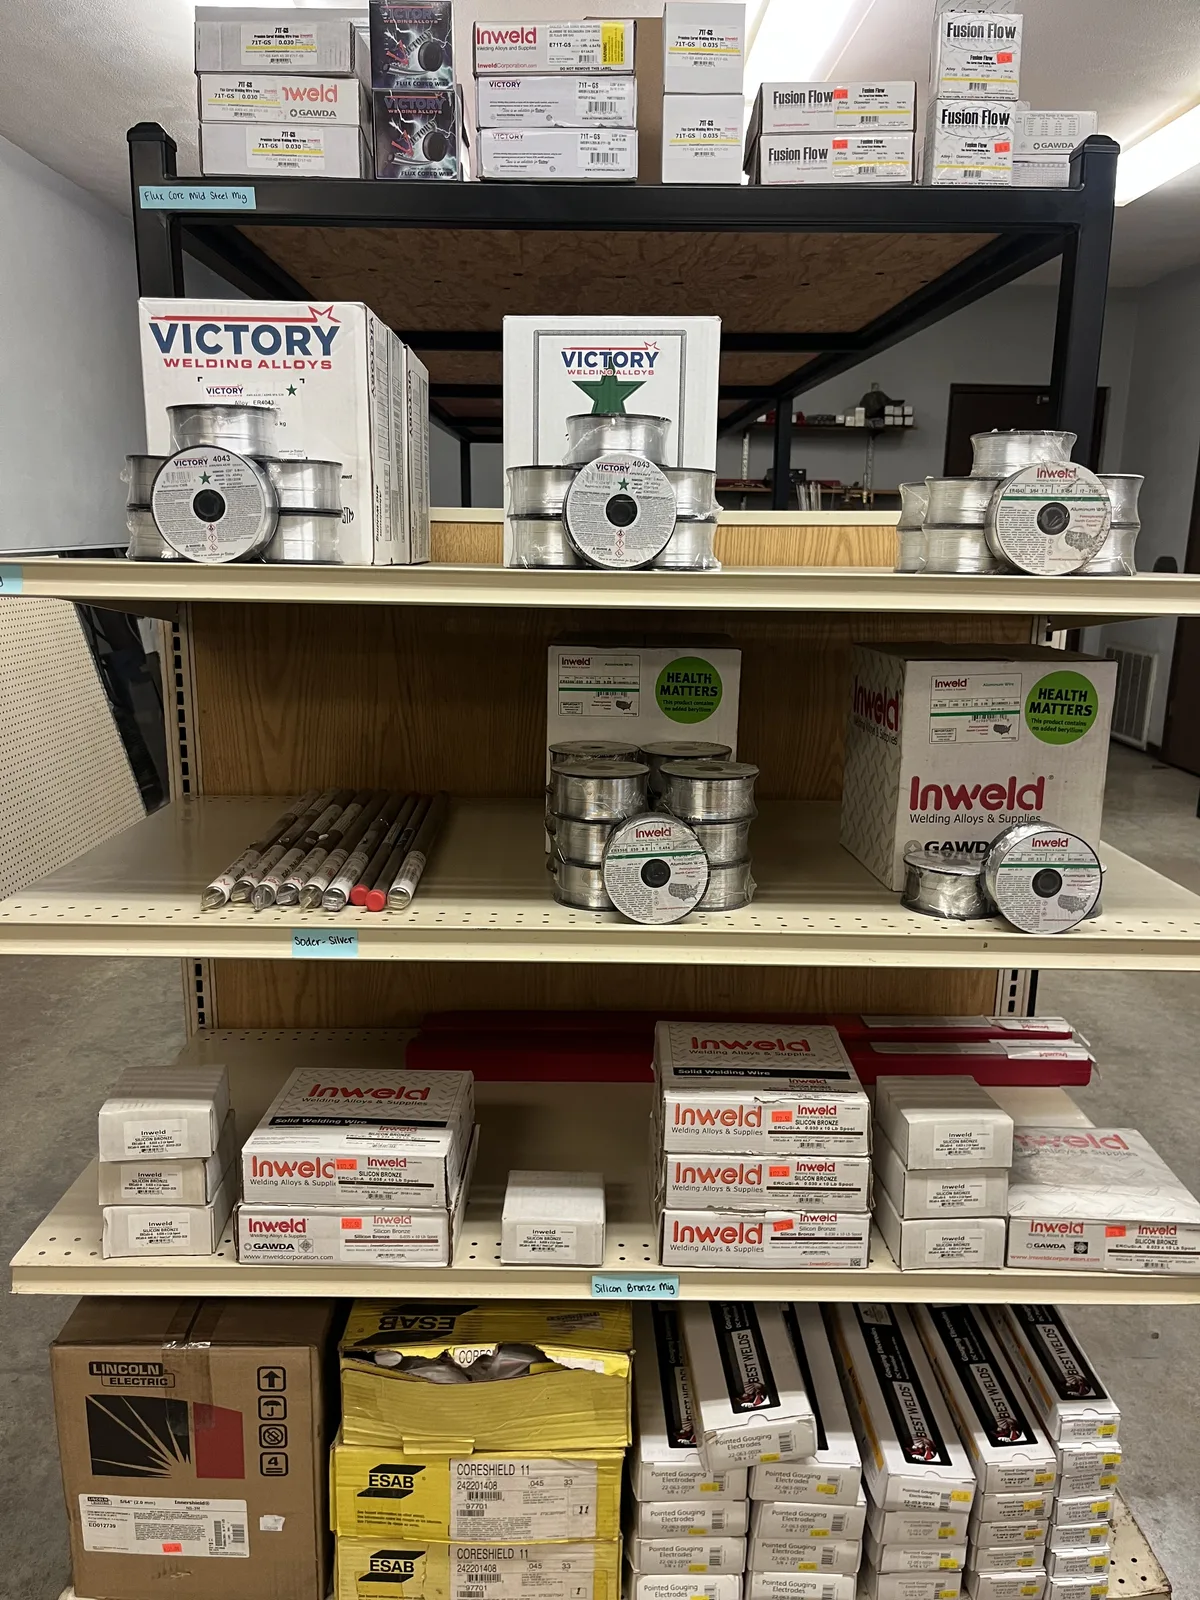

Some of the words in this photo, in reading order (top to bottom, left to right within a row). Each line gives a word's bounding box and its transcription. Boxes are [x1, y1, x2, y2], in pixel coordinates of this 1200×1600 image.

[476, 26, 536, 44] Inweld
[947, 22, 984, 38] Fusion
[988, 23, 1016, 38] Flow
[773, 91, 806, 104] Fusion
[808, 90, 834, 104] Flow
[942, 109, 978, 125] Fusion
[981, 109, 1010, 125] Flow
[768, 148, 800, 162] Fusion
[803, 147, 828, 160] Flow
[144, 191, 164, 201] Flux
[168, 191, 184, 200] Core
[190, 192, 206, 200] Mild
[210, 191, 228, 200] Steel
[232, 191, 248, 204] Mig
[148, 323, 341, 356] VICTORY
[164, 358, 252, 369] WELDING
[258, 360, 332, 370] ALLOYS
[561, 351, 659, 369] VICTORY
[666, 672, 712, 684] HEALTH
[660, 685, 718, 697] MATTERS
[1038, 688, 1088, 702] HEALTH
[1029, 702, 1093, 716] MATTERS
[909, 776, 1045, 811] Inweld
[910, 814, 950, 824] Welding
[954, 814, 984, 824] Alloys
[987, 814, 995, 823] &
[998, 814, 1041, 824] Supplies
[328, 936, 355, 945] Silver
[691, 1037, 810, 1051] Inweld
[308, 1084, 431, 1100] Inweld
[674, 1103, 763, 1127] Inweld
[672, 1127, 700, 1136] Welding
[702, 1128, 724, 1136] Alloys
[734, 1128, 763, 1136] Supplies
[675, 1162, 763, 1185] Inweld
[672, 1184, 700, 1193] Welding
[703, 1185, 725, 1193] Alloys
[734, 1186, 763, 1194] Supplies
[673, 1221, 763, 1244] Inweld
[670, 1244, 699, 1253] Welding
[701, 1244, 723, 1253] Alloys
[733, 1245, 764, 1253] Supplies
[595, 1283, 622, 1293] Silicon
[627, 1282, 656, 1292] Bronze
[659, 1283, 675, 1295] Mig
[92, 1364, 160, 1375] LINCOLN
[877, 1354, 893, 1378] Gouging
[109, 1377, 168, 1386] ELECTRIC
[977, 1368, 998, 1397] WELDS
[900, 1386, 920, 1416] WELDS
[990, 1397, 1010, 1418] BEST
[912, 1416, 928, 1439] BEST
[715, 1437, 741, 1446] Pointed
[742, 1434, 772, 1443] Gouging
[727, 1441, 761, 1450] Electrodes
[268, 1457, 279, 1466] 4
[456, 1464, 515, 1477] CORESHIELD
[521, 1465, 530, 1475] 11
[369, 1474, 414, 1489] ESAB
[457, 1481, 498, 1490] 242201408
[578, 1506, 589, 1515] 11
[456, 1548, 514, 1560] CORESHIELD
[520, 1549, 528, 1559] 11
[370, 1560, 414, 1572] ESAB
[457, 1564, 497, 1573] 242201408
